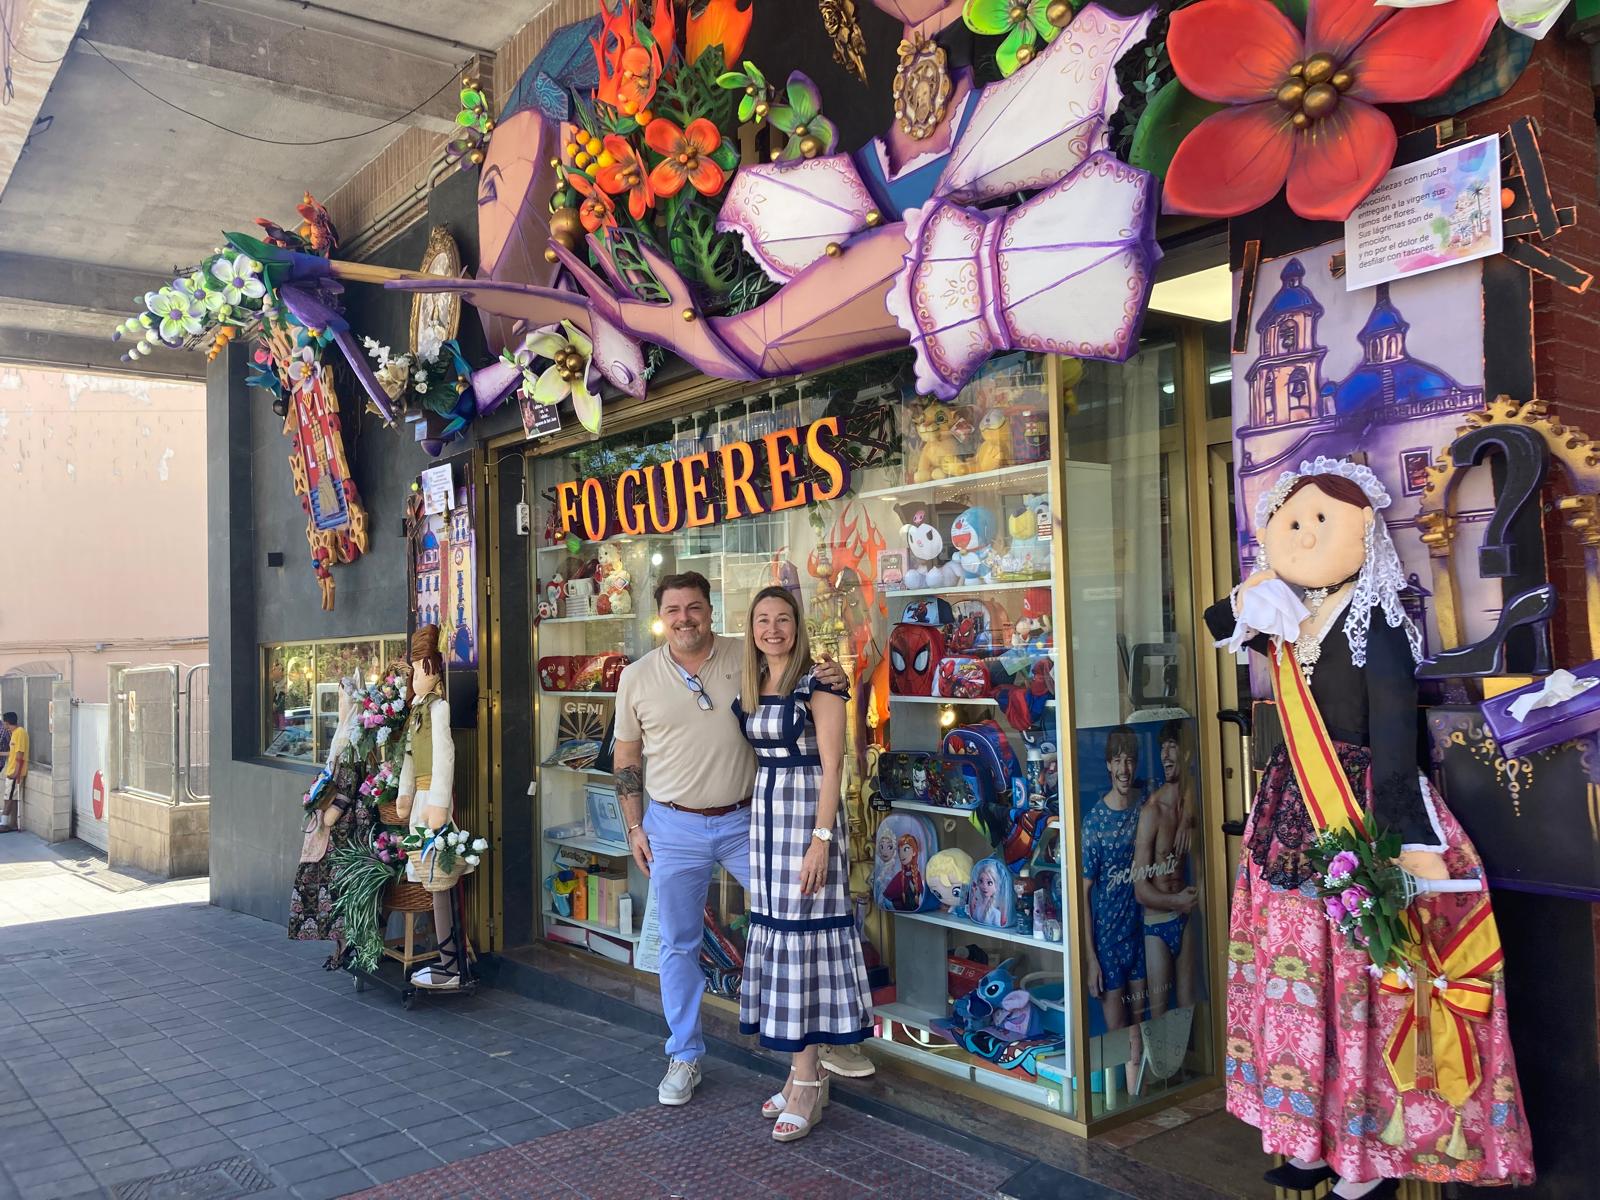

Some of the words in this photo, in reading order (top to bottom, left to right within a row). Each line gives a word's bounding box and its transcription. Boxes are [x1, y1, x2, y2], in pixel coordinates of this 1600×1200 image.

[1404, 176, 1418, 185] con
[1420, 166, 1447, 180] mucha
[1358, 204, 1390, 220] entregan
[1406, 192, 1430, 204] virgen
[1432, 187, 1446, 197] sus
[1358, 219, 1380, 229] ramos
[1382, 213, 1392, 222] de
[1359, 231, 1371, 239] Sus
[1373, 220, 1405, 235] lágrimas
[1408, 216, 1422, 225] son
[1424, 212, 1434, 221] de
[1359, 235, 1392, 249] emoción,
[1375, 247, 1387, 256] por
[1398, 238, 1418, 250] dolor
[1419, 234, 1429, 243] de
[1359, 256, 1386, 269] desfilar
[1387, 253, 1402, 261] con
